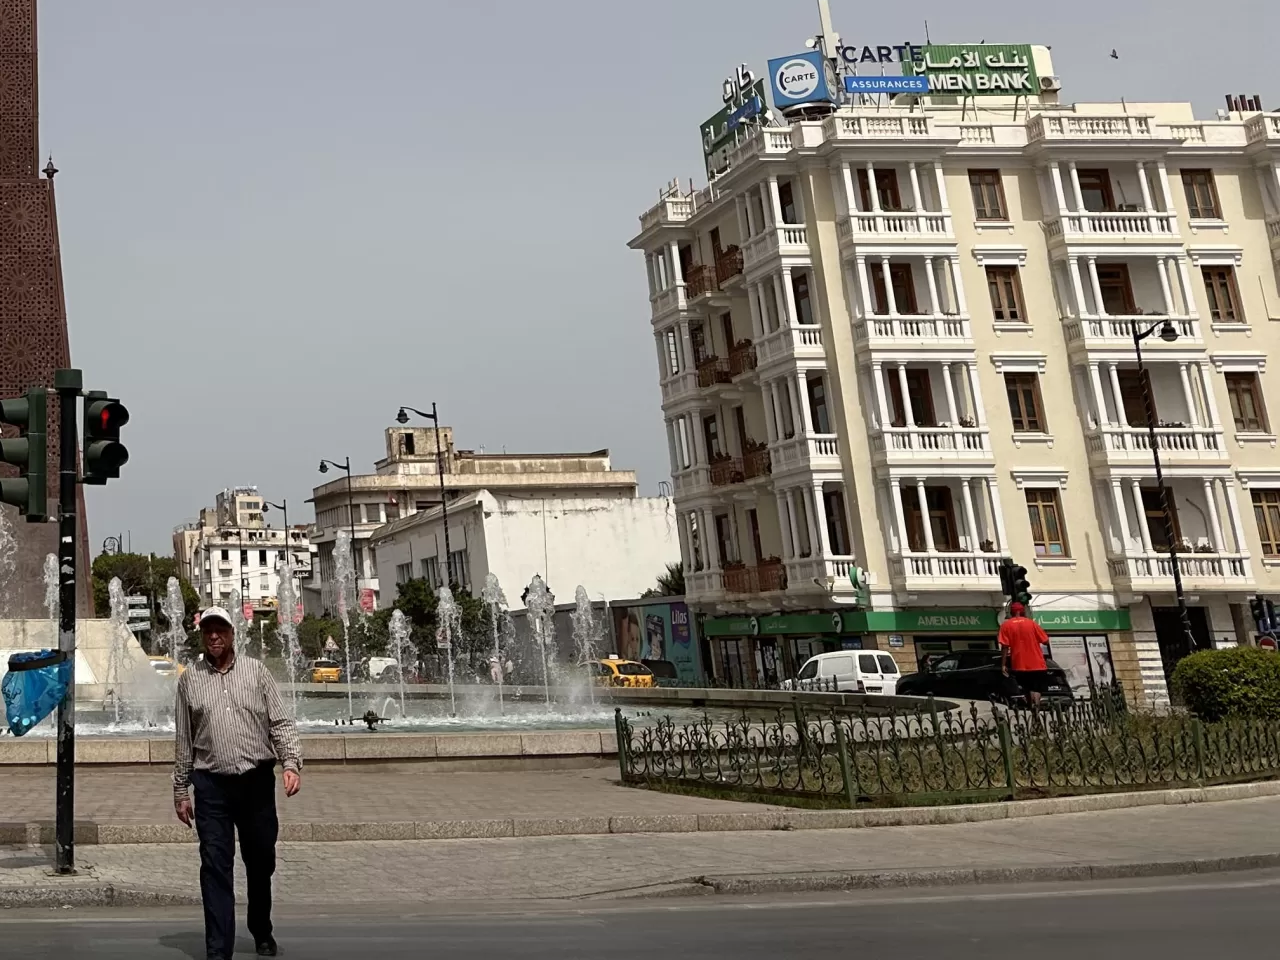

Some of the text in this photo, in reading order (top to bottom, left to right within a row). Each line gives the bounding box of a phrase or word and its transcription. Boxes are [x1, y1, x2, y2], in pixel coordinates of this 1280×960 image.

[841, 45, 924, 63] CARTE
[985, 49, 1029, 72] بنك
[784, 72, 816, 84] CARTE
[851, 80, 923, 89] ASSURANCES
[927, 73, 1032, 90] MEN BANK
[672, 610, 688, 624] Lilas
[917, 615, 981, 626] AMEN BANK
[1073, 614, 1097, 624] بنك
